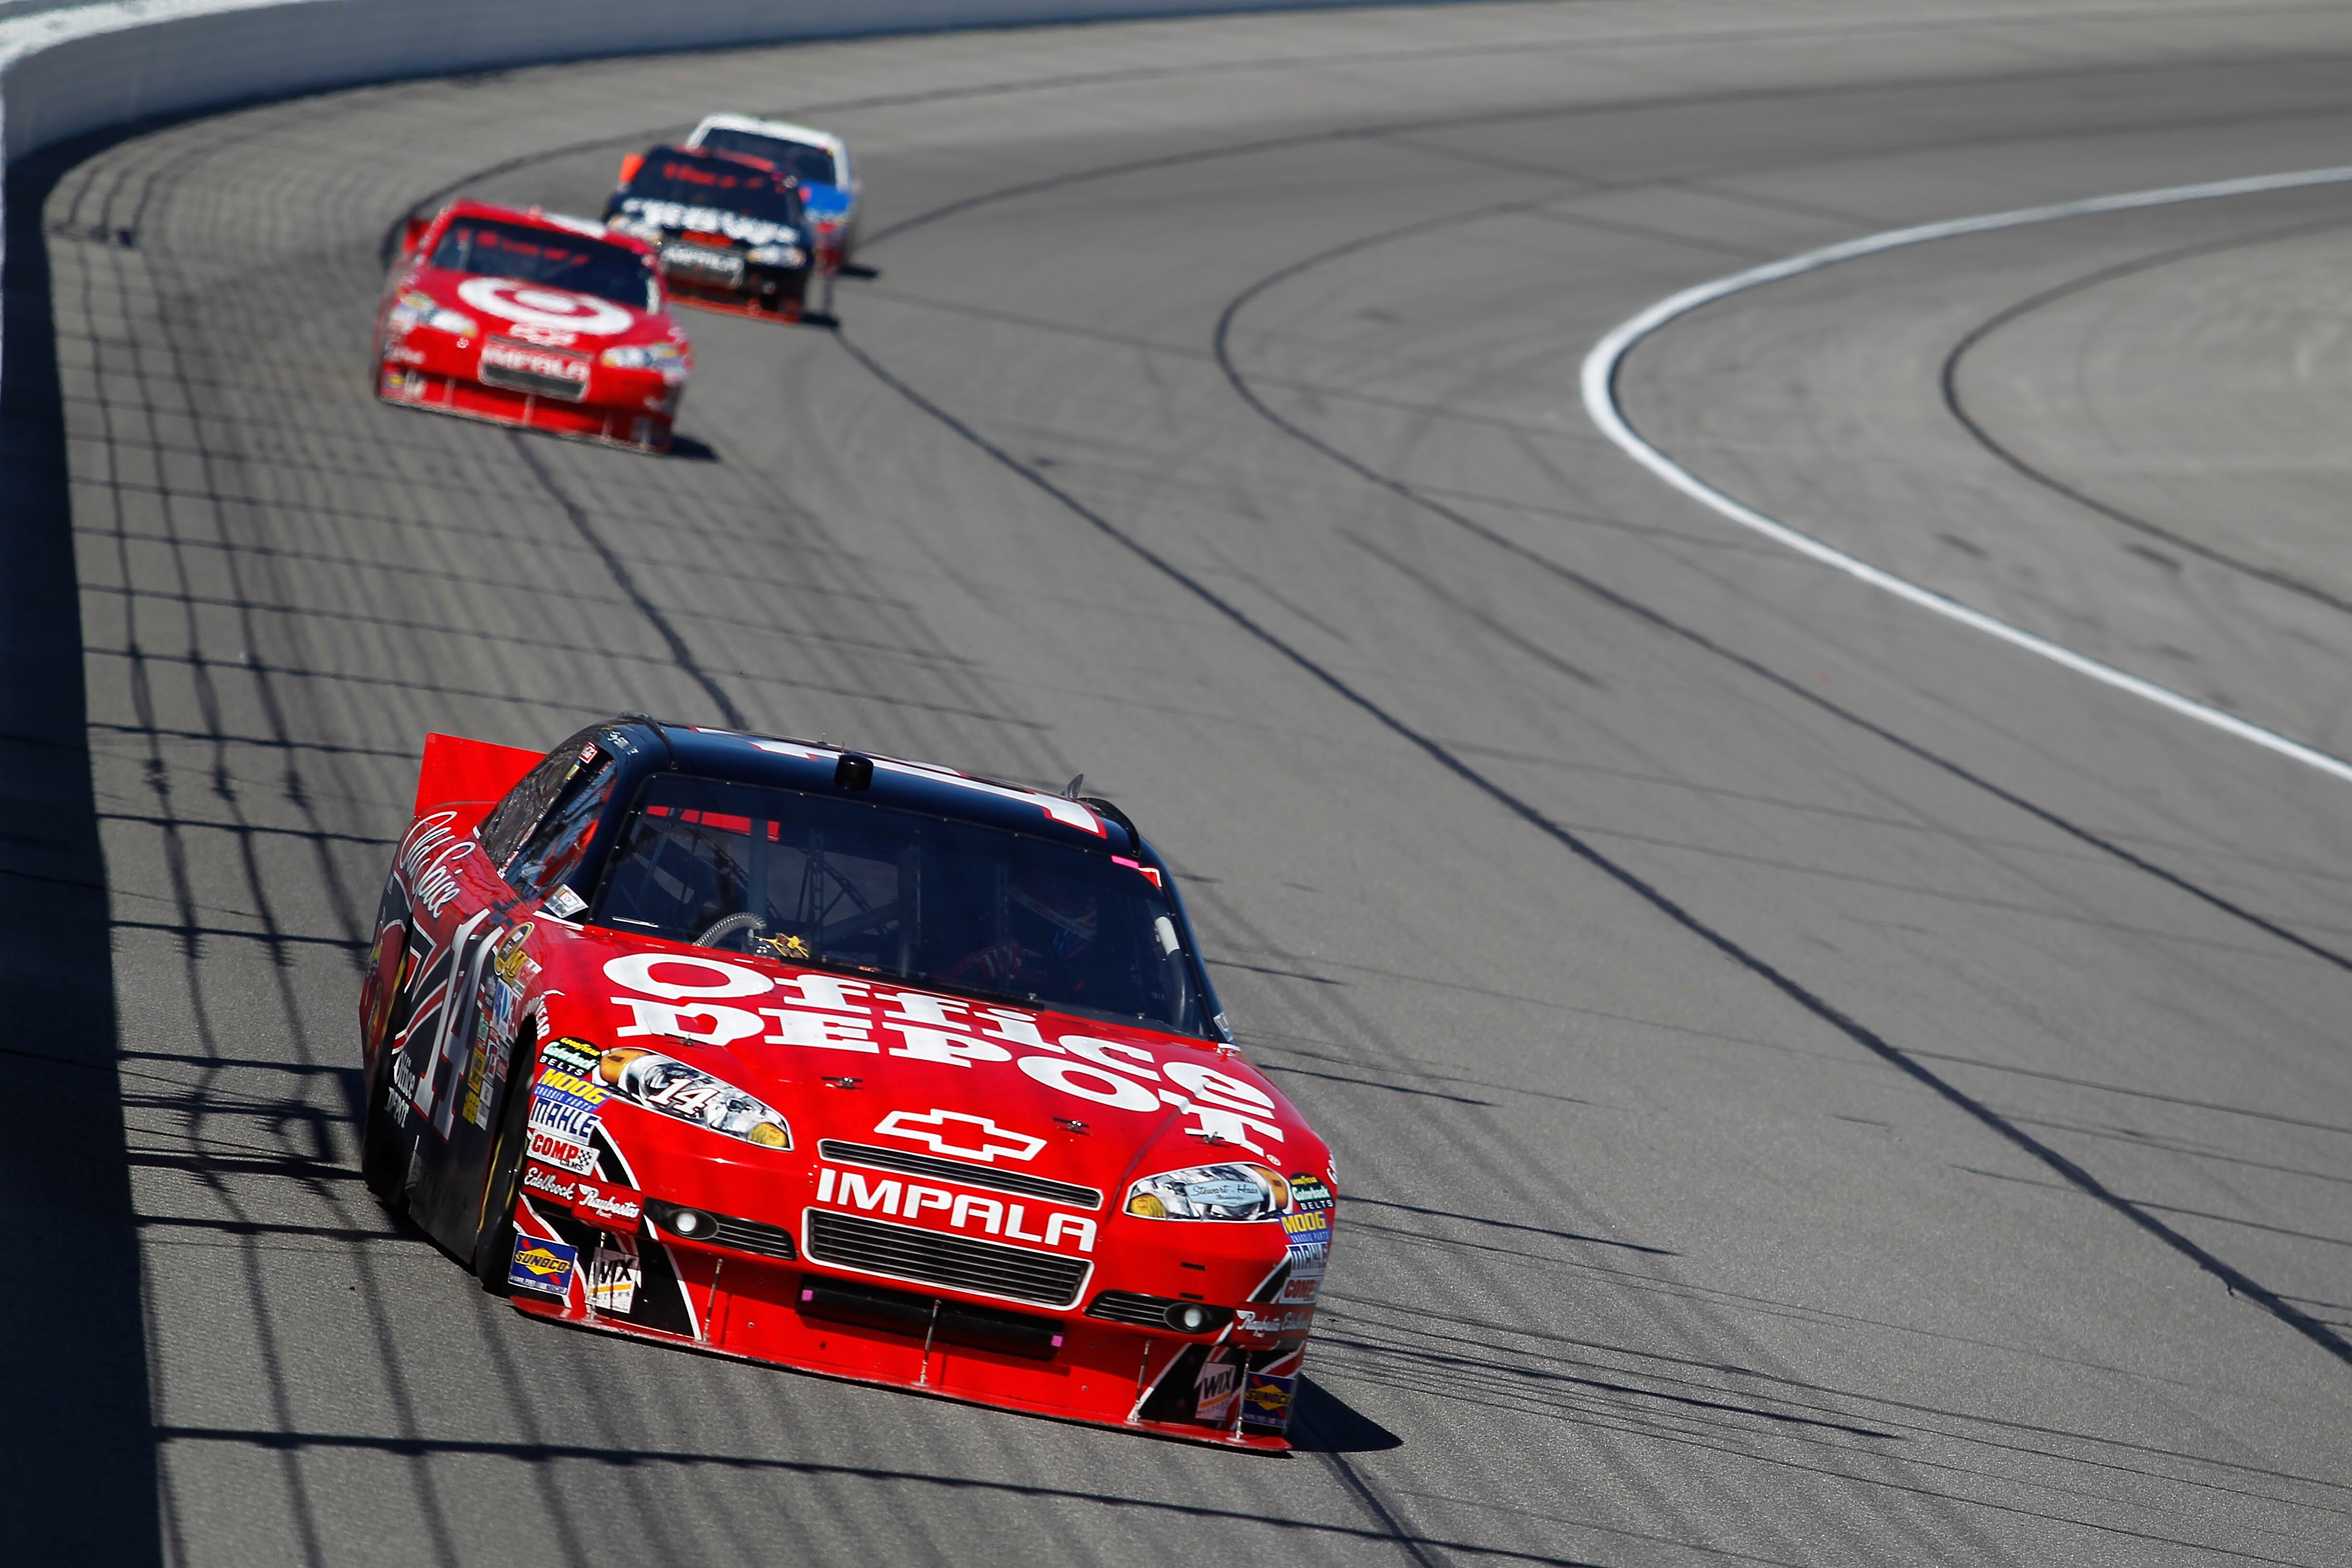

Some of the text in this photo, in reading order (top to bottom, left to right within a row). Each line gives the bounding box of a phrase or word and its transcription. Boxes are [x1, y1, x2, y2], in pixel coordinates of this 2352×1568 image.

[412, 842, 476, 918] Spice
[560, 1037, 600, 1056] GOODYEAR
[603, 953, 1275, 1118] Office
[539, 1055, 585, 1076] BELTS
[543, 1041, 599, 1070] Gatorback
[538, 1068, 612, 1104] MOOG
[610, 996, 1284, 1156] DEPOT
[648, 1078, 719, 1115] 14
[530, 1098, 599, 1139] MAHLE
[532, 1134, 579, 1161] COMP
[560, 1159, 584, 1171] CAMS
[524, 1167, 575, 1200] Edelbrock
[815, 1168, 1098, 1253] IMPALA
[1300, 1200, 1334, 1210] BELTS
[1281, 1211, 1326, 1235] MOOG
[514, 1252, 571, 1272] SUNOCO
[1203, 1368, 1233, 1400] WIX
